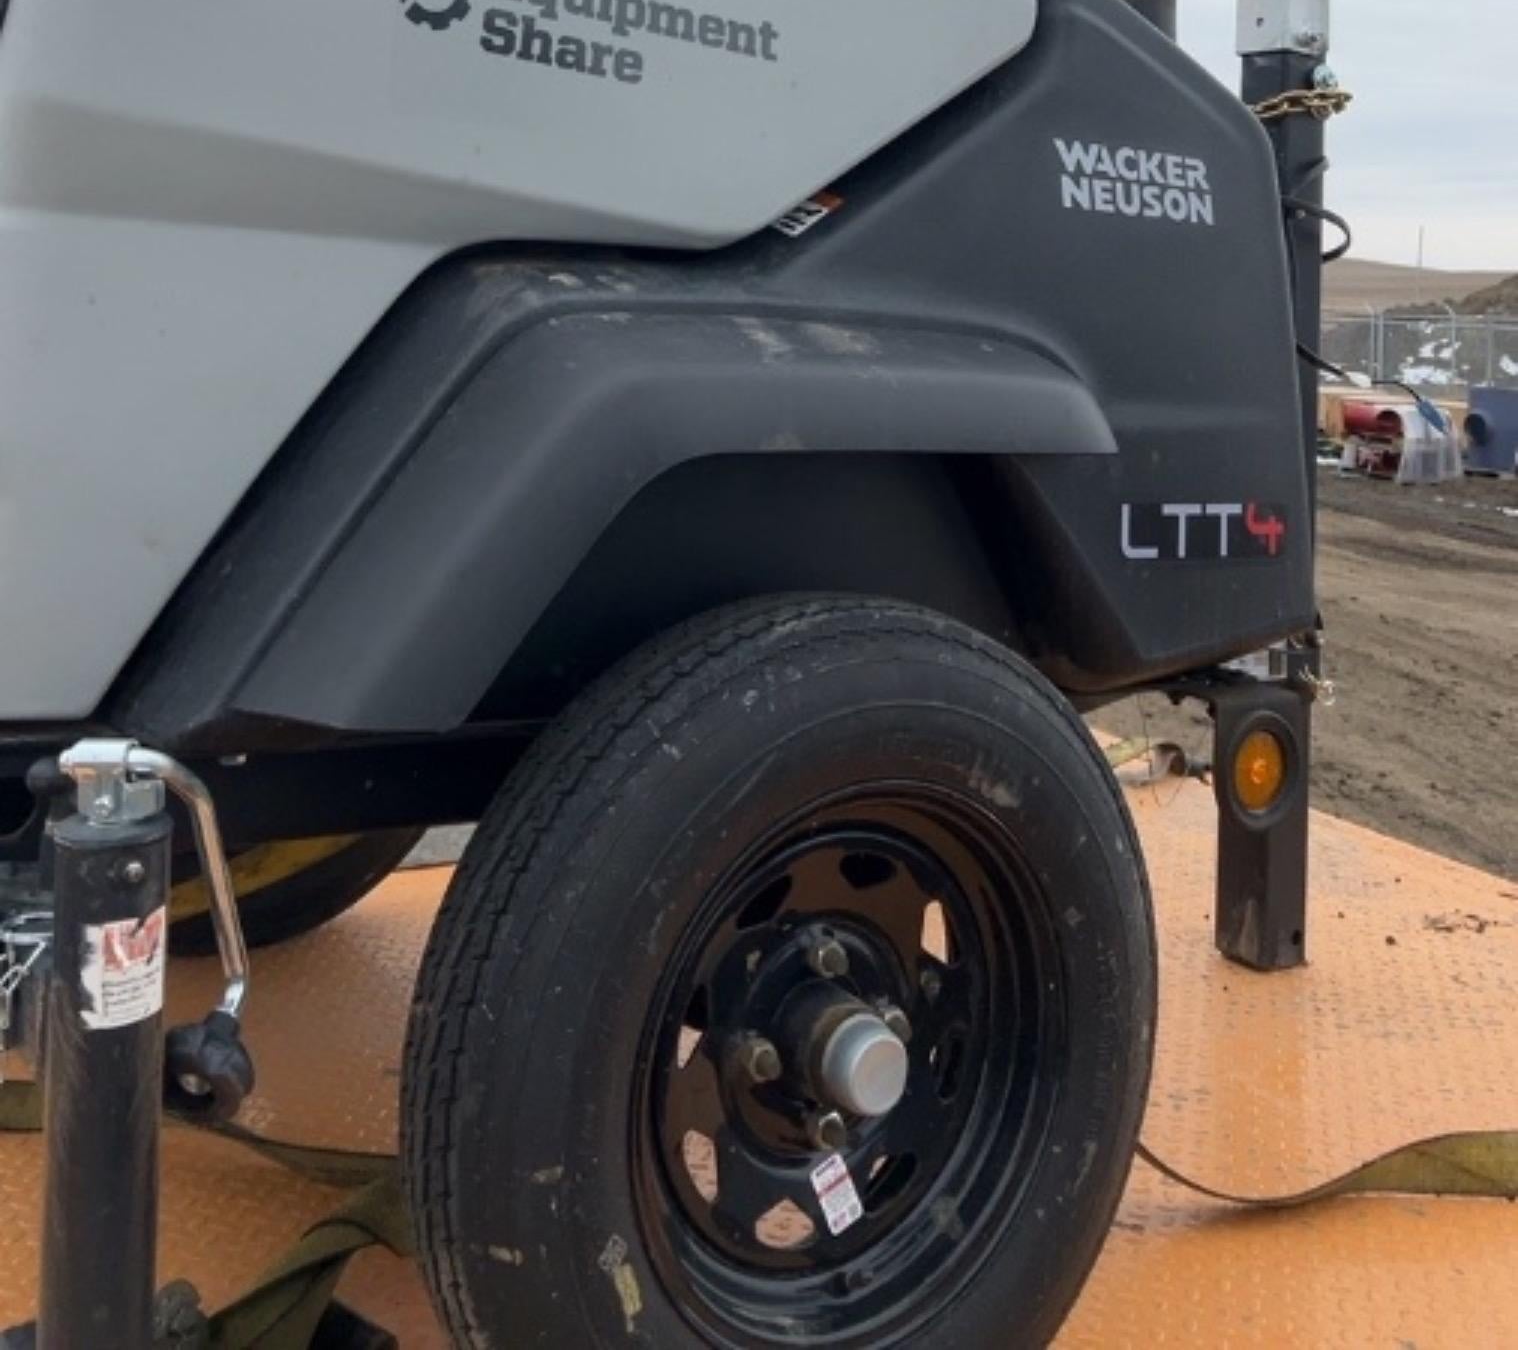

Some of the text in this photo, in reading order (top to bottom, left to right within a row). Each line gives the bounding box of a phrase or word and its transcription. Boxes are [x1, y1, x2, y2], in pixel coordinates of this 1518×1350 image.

[479, 7, 645, 84] Share
[1052, 136, 1211, 191] WACKER
[1060, 172, 1216, 227] NEUSON
[1120, 502, 1286, 559] LTT4
